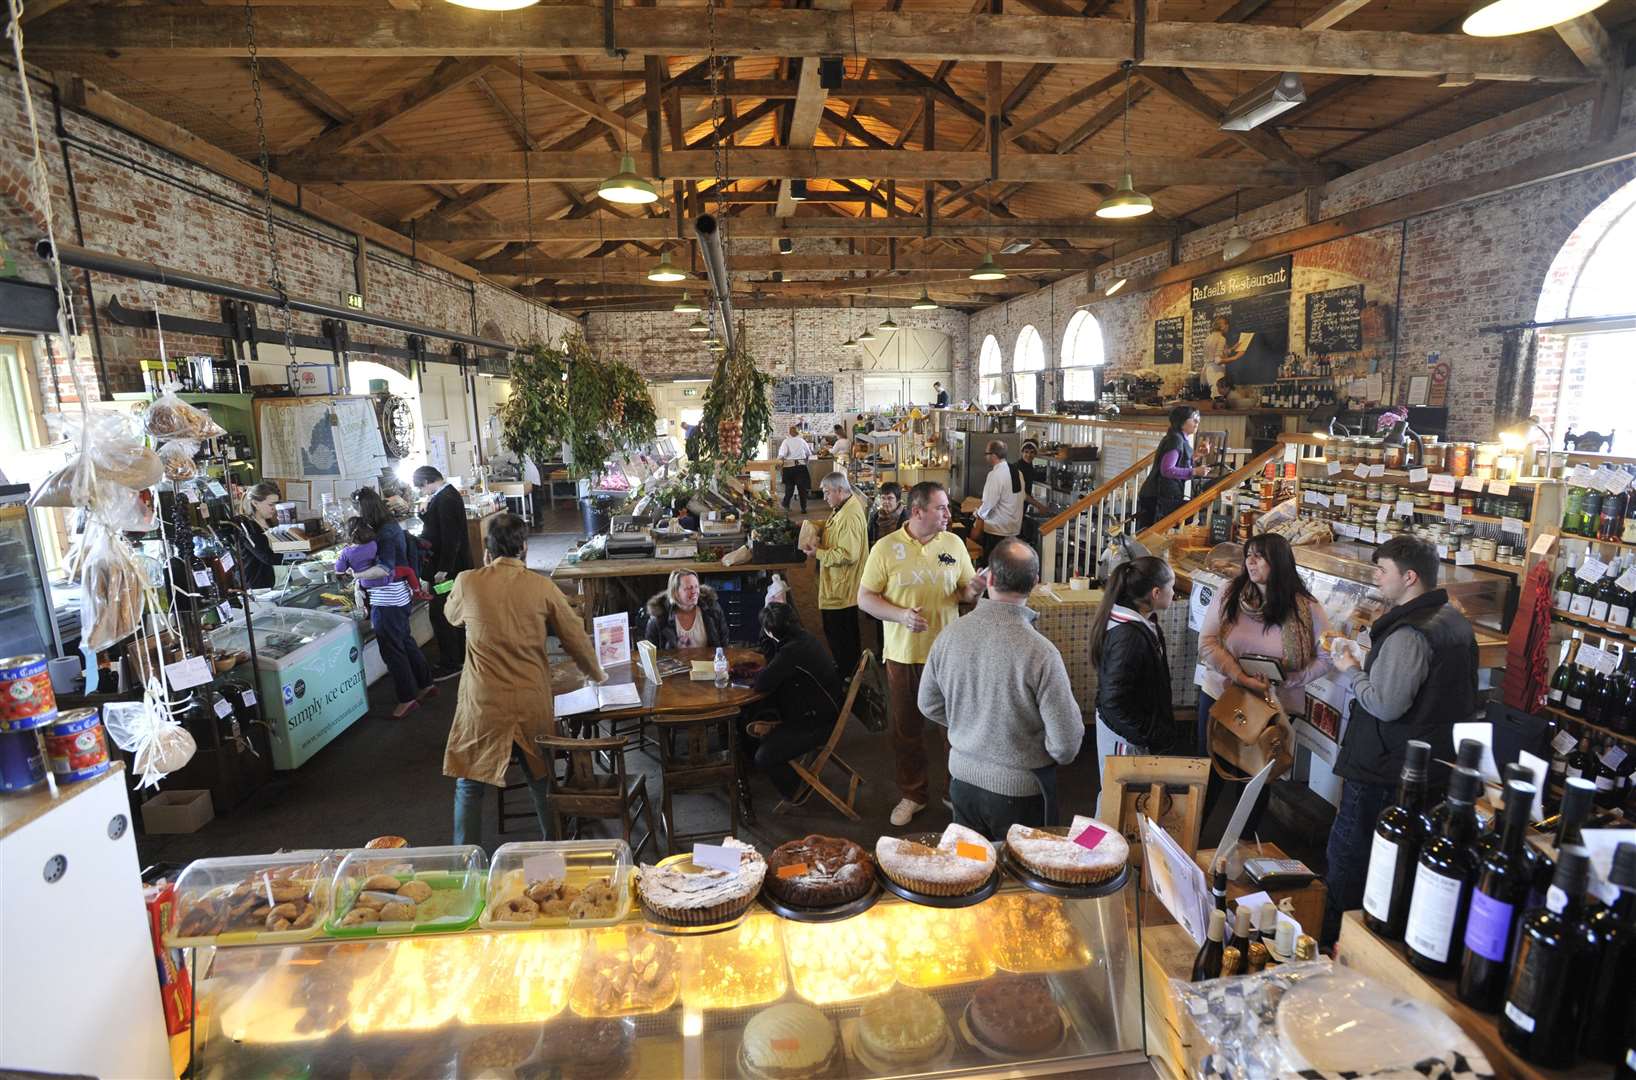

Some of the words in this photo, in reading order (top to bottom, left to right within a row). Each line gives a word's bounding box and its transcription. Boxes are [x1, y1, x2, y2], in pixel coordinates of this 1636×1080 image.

[1192, 280, 1226, 302] Rafael's
[1228, 266, 1287, 293] Restaurant
[892, 543, 906, 560] 3
[288, 697, 323, 731] simply
[325, 687, 338, 705] ice
[340, 668, 366, 694] cream
